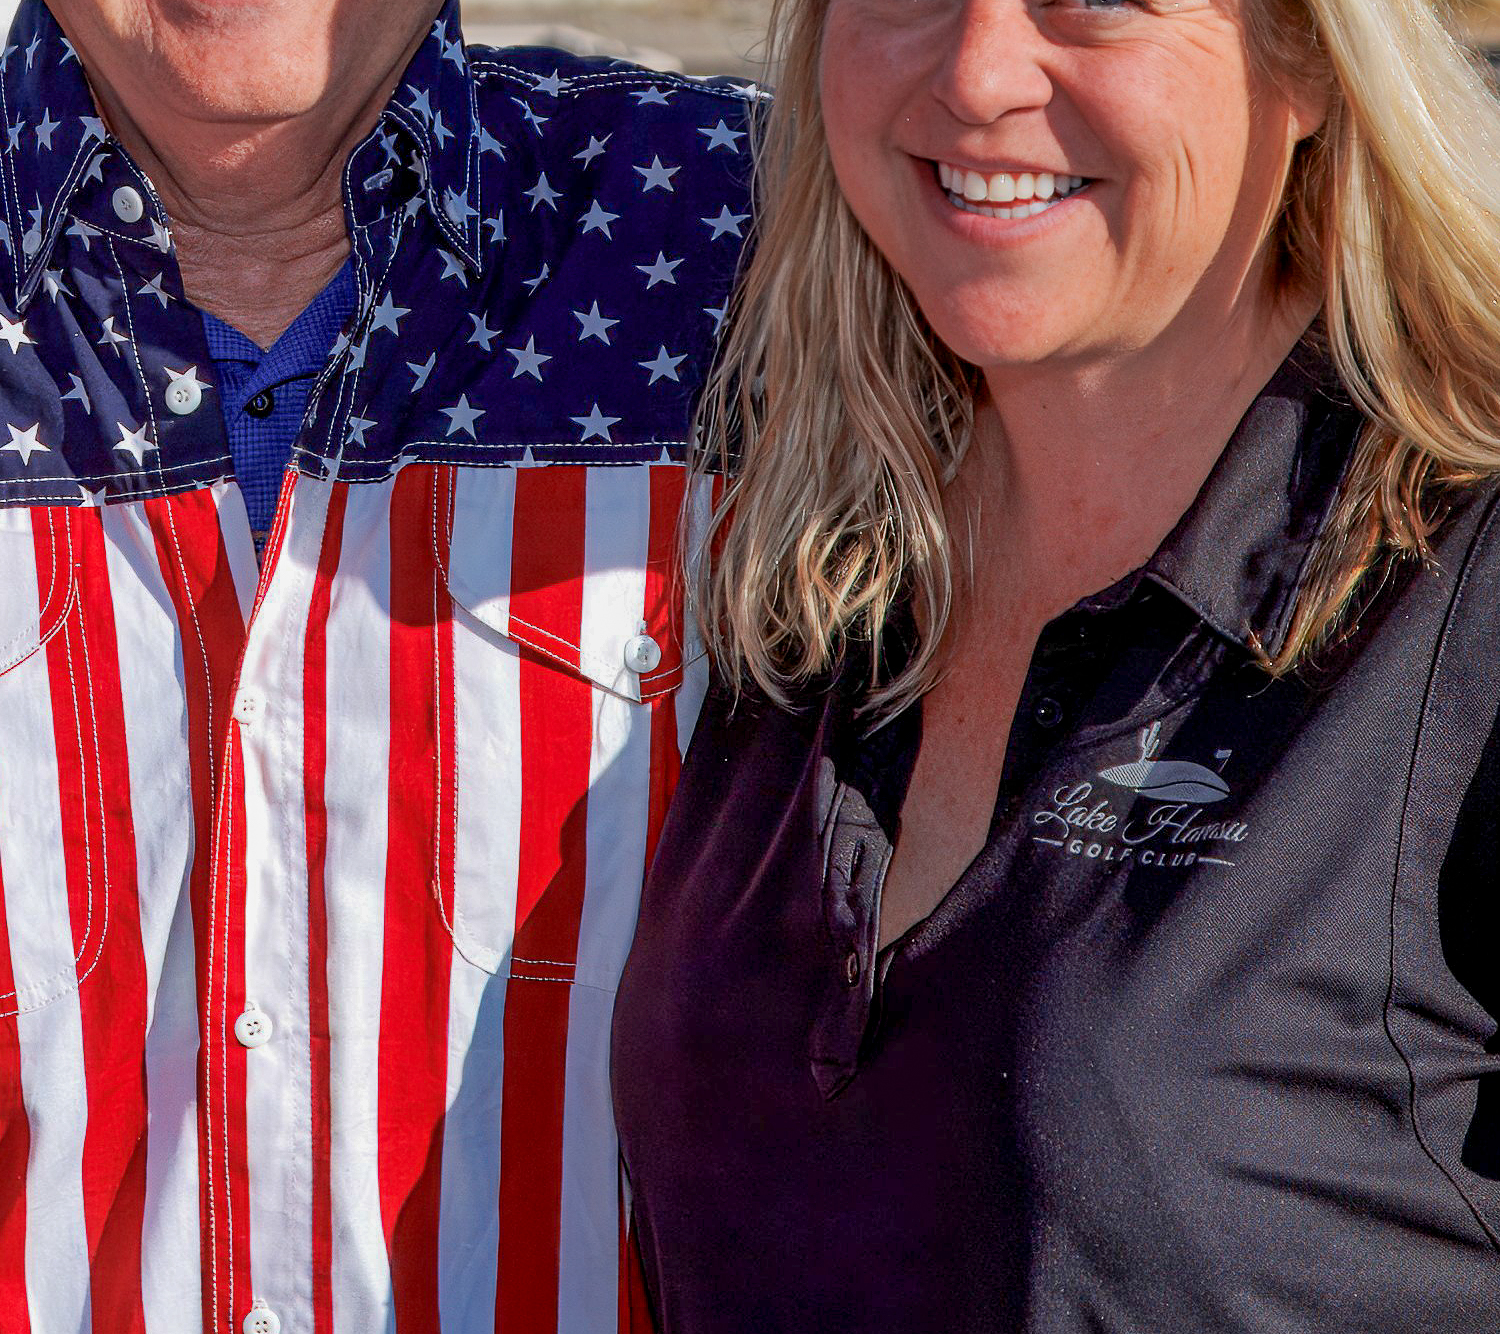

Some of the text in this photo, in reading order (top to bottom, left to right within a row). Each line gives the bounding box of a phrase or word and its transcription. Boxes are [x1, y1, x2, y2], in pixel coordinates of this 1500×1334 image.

[1034, 782, 1118, 839] Lake
[1068, 839, 1198, 867] GOLF CLUB
